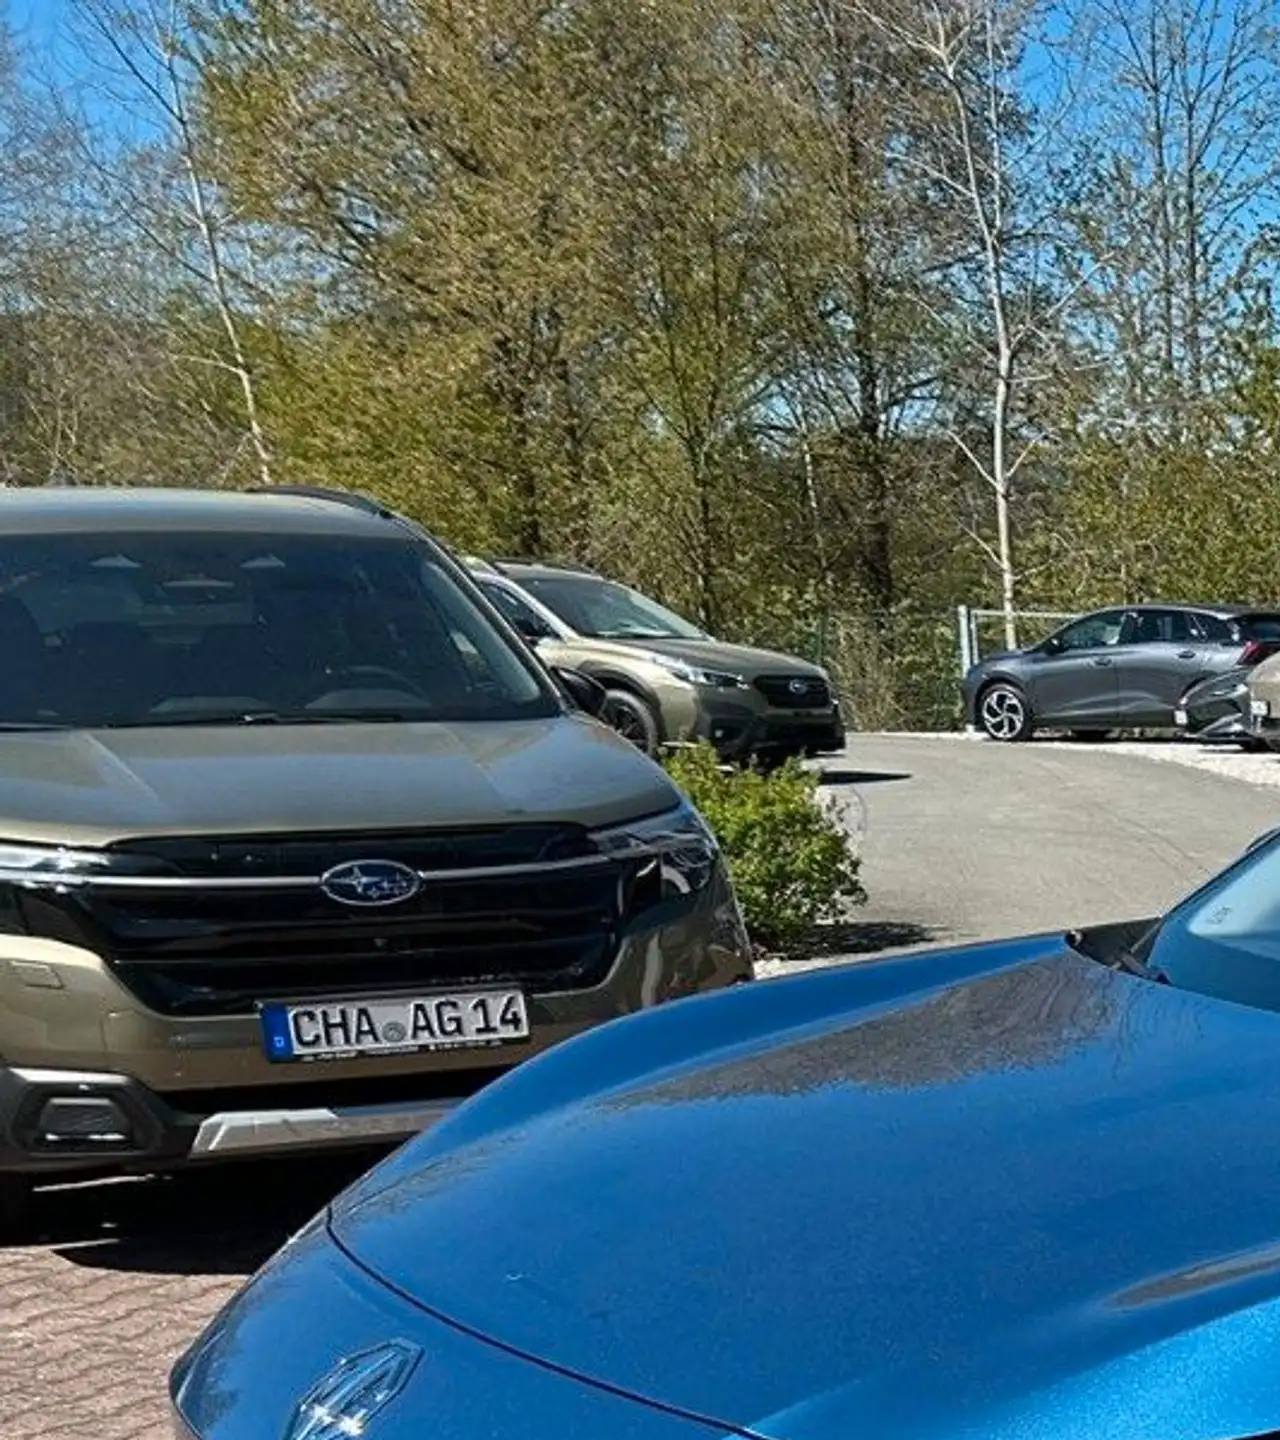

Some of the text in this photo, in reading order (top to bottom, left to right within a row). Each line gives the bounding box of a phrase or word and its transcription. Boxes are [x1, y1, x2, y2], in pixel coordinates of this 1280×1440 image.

[292, 1007, 382, 1048] CHA
[411, 1001, 464, 1040] AG
[471, 996, 522, 1034] 14
